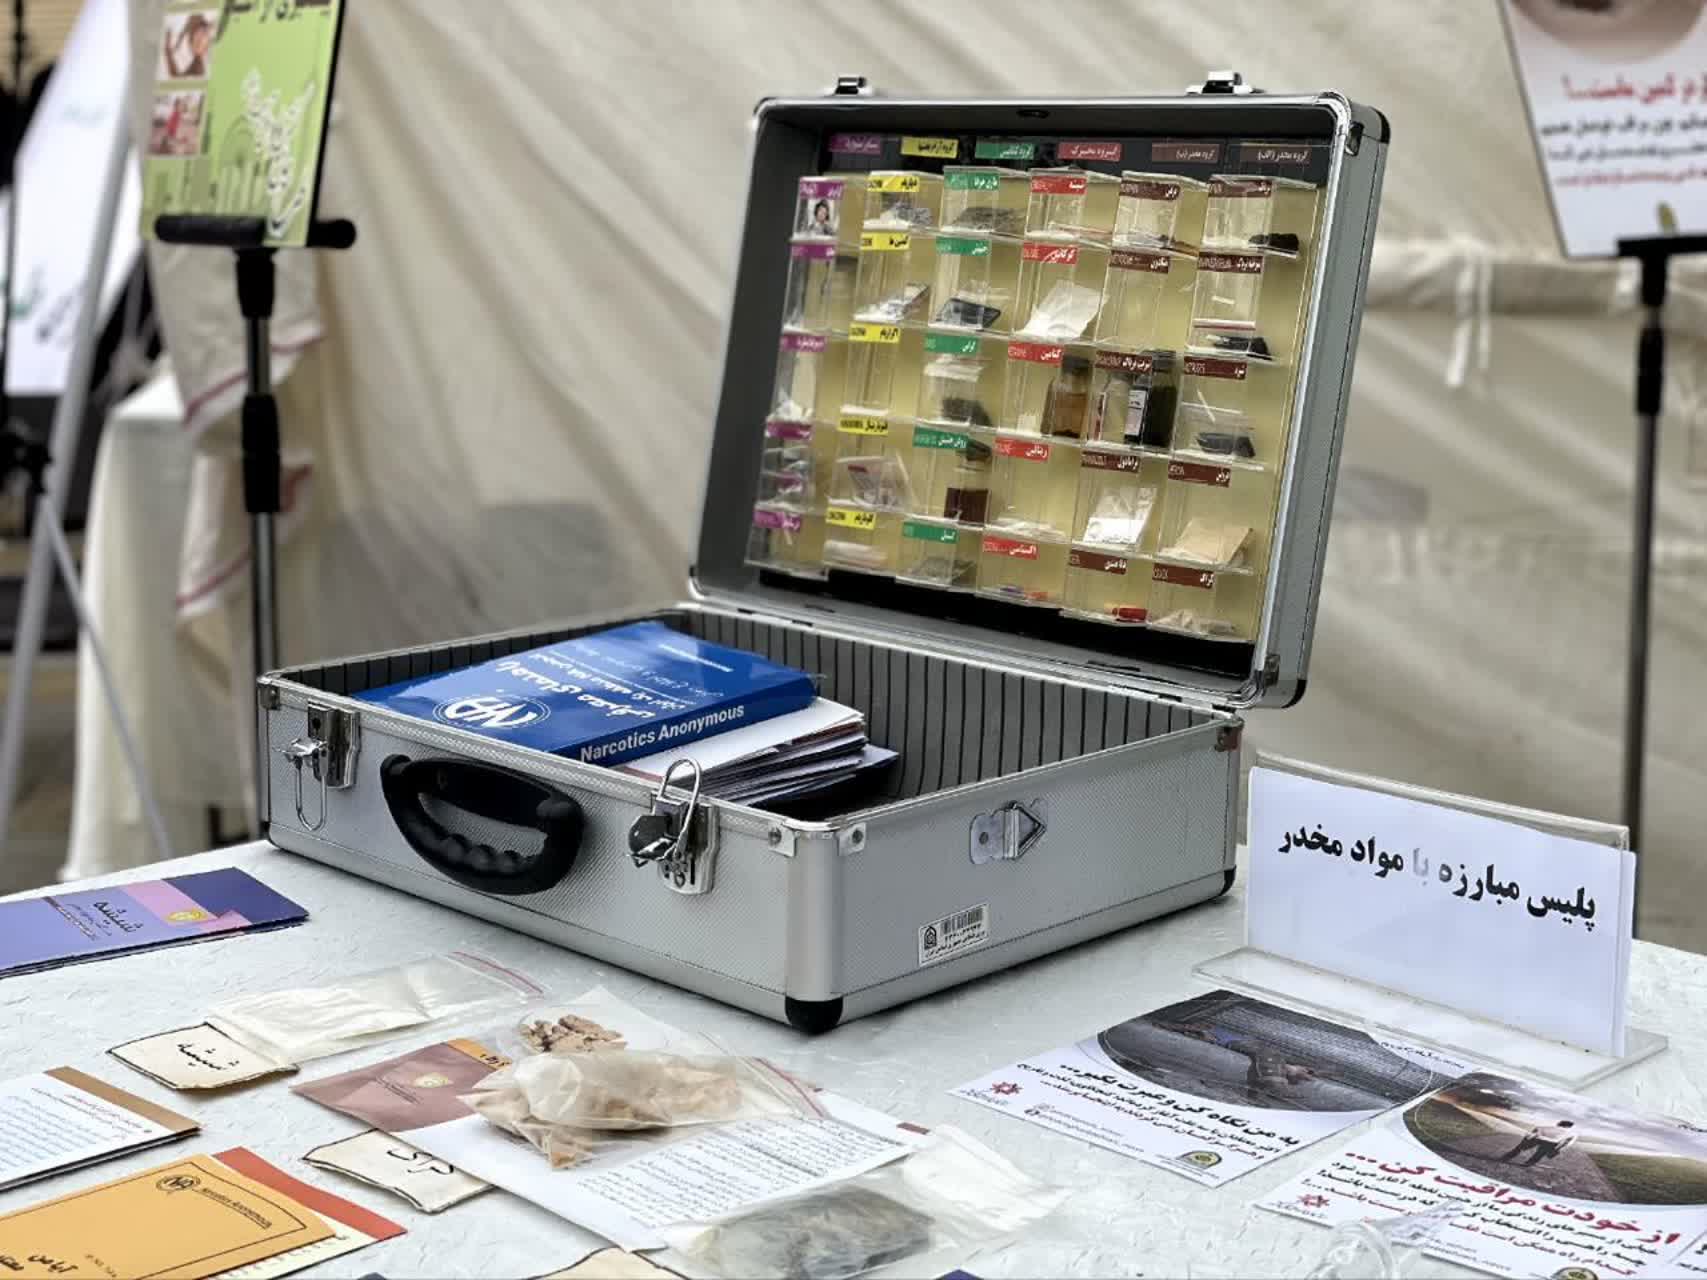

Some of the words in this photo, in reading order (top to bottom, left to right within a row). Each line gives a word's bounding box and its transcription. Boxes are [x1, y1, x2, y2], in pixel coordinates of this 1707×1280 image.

[580, 730, 656, 763] Narcotics
[657, 704, 745, 741] Anonymous
[1277, 823, 1344, 857] مخدر
[1349, 836, 1405, 879] مواد
[1411, 846, 1431, 886] با
[1438, 862, 1521, 906] مبارزه
[93, 901, 144, 933] شیشه
[1526, 887, 1597, 933] پلیس
[1172, 1104, 1214, 1114] کن
[1242, 1128, 1277, 1139] من
[1434, 1175, 1537, 1207] مراقبت
[1541, 1203, 1641, 1233] خودت
[1637, 1230, 1681, 1245] از
